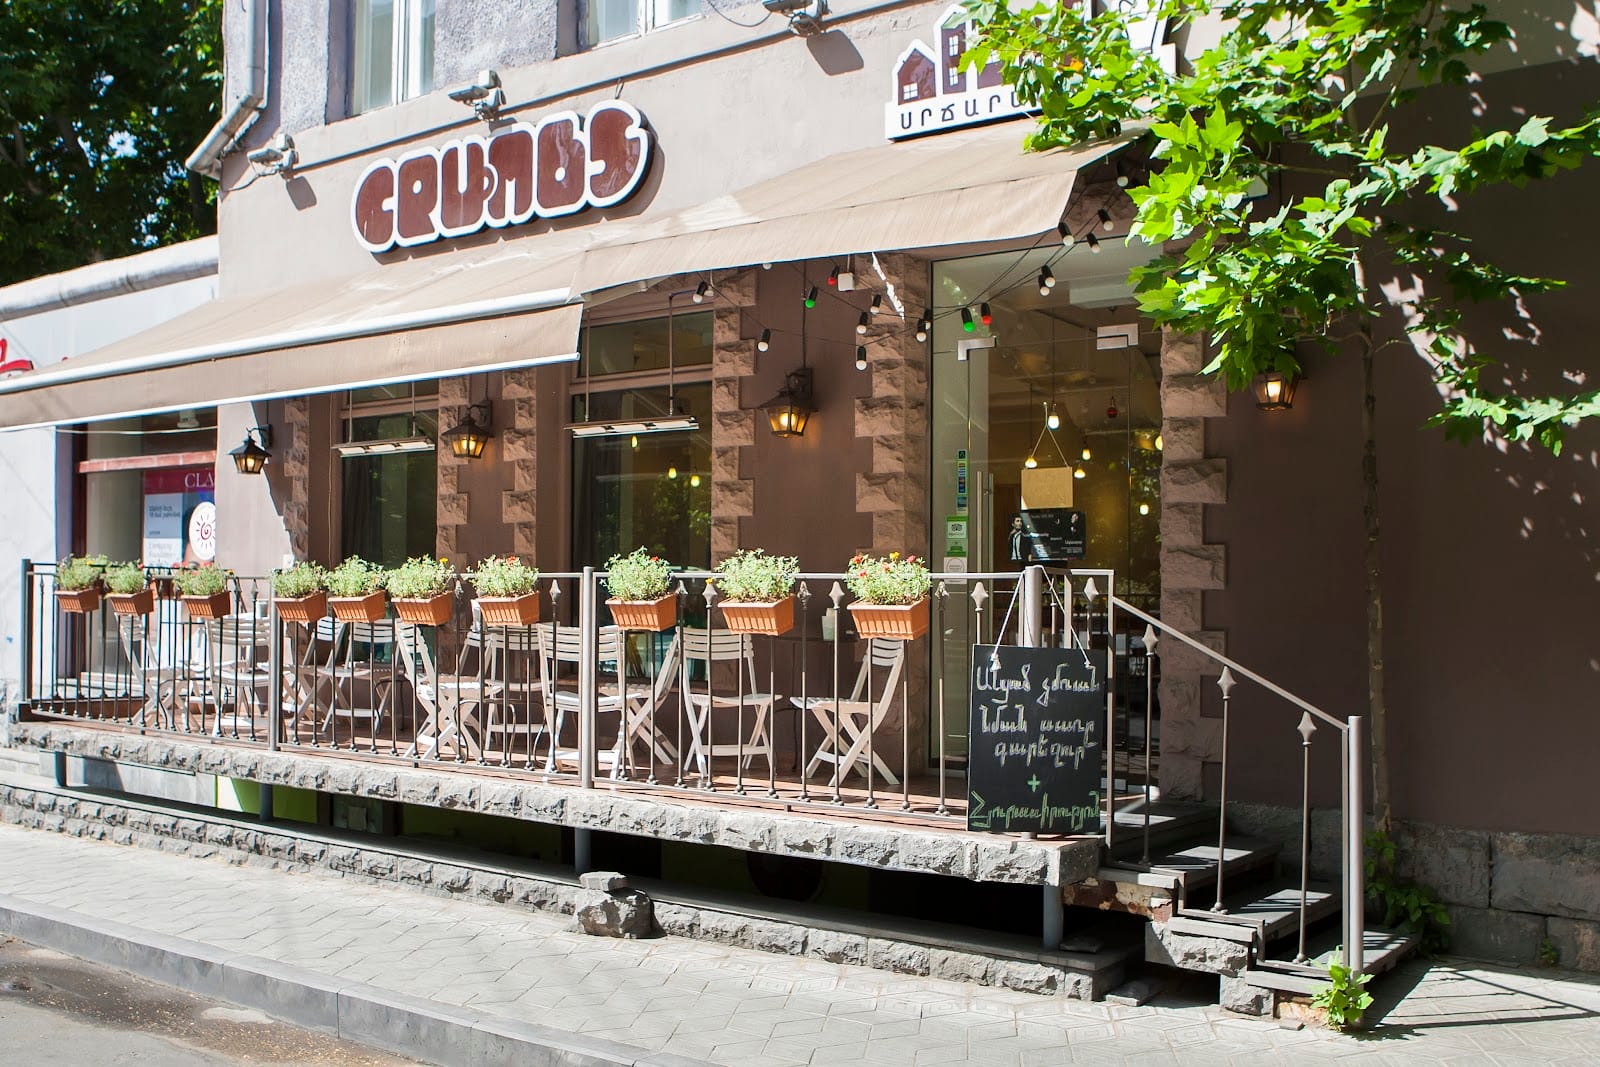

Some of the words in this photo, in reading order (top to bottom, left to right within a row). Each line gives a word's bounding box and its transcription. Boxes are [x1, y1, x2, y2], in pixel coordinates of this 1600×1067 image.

[900, 89, 1024, 130] ՍՐՃԱՐԱ
[353, 102, 646, 250] CRUMBS
[184, 472, 215, 488] CLA
[1027, 773, 1041, 793] +
